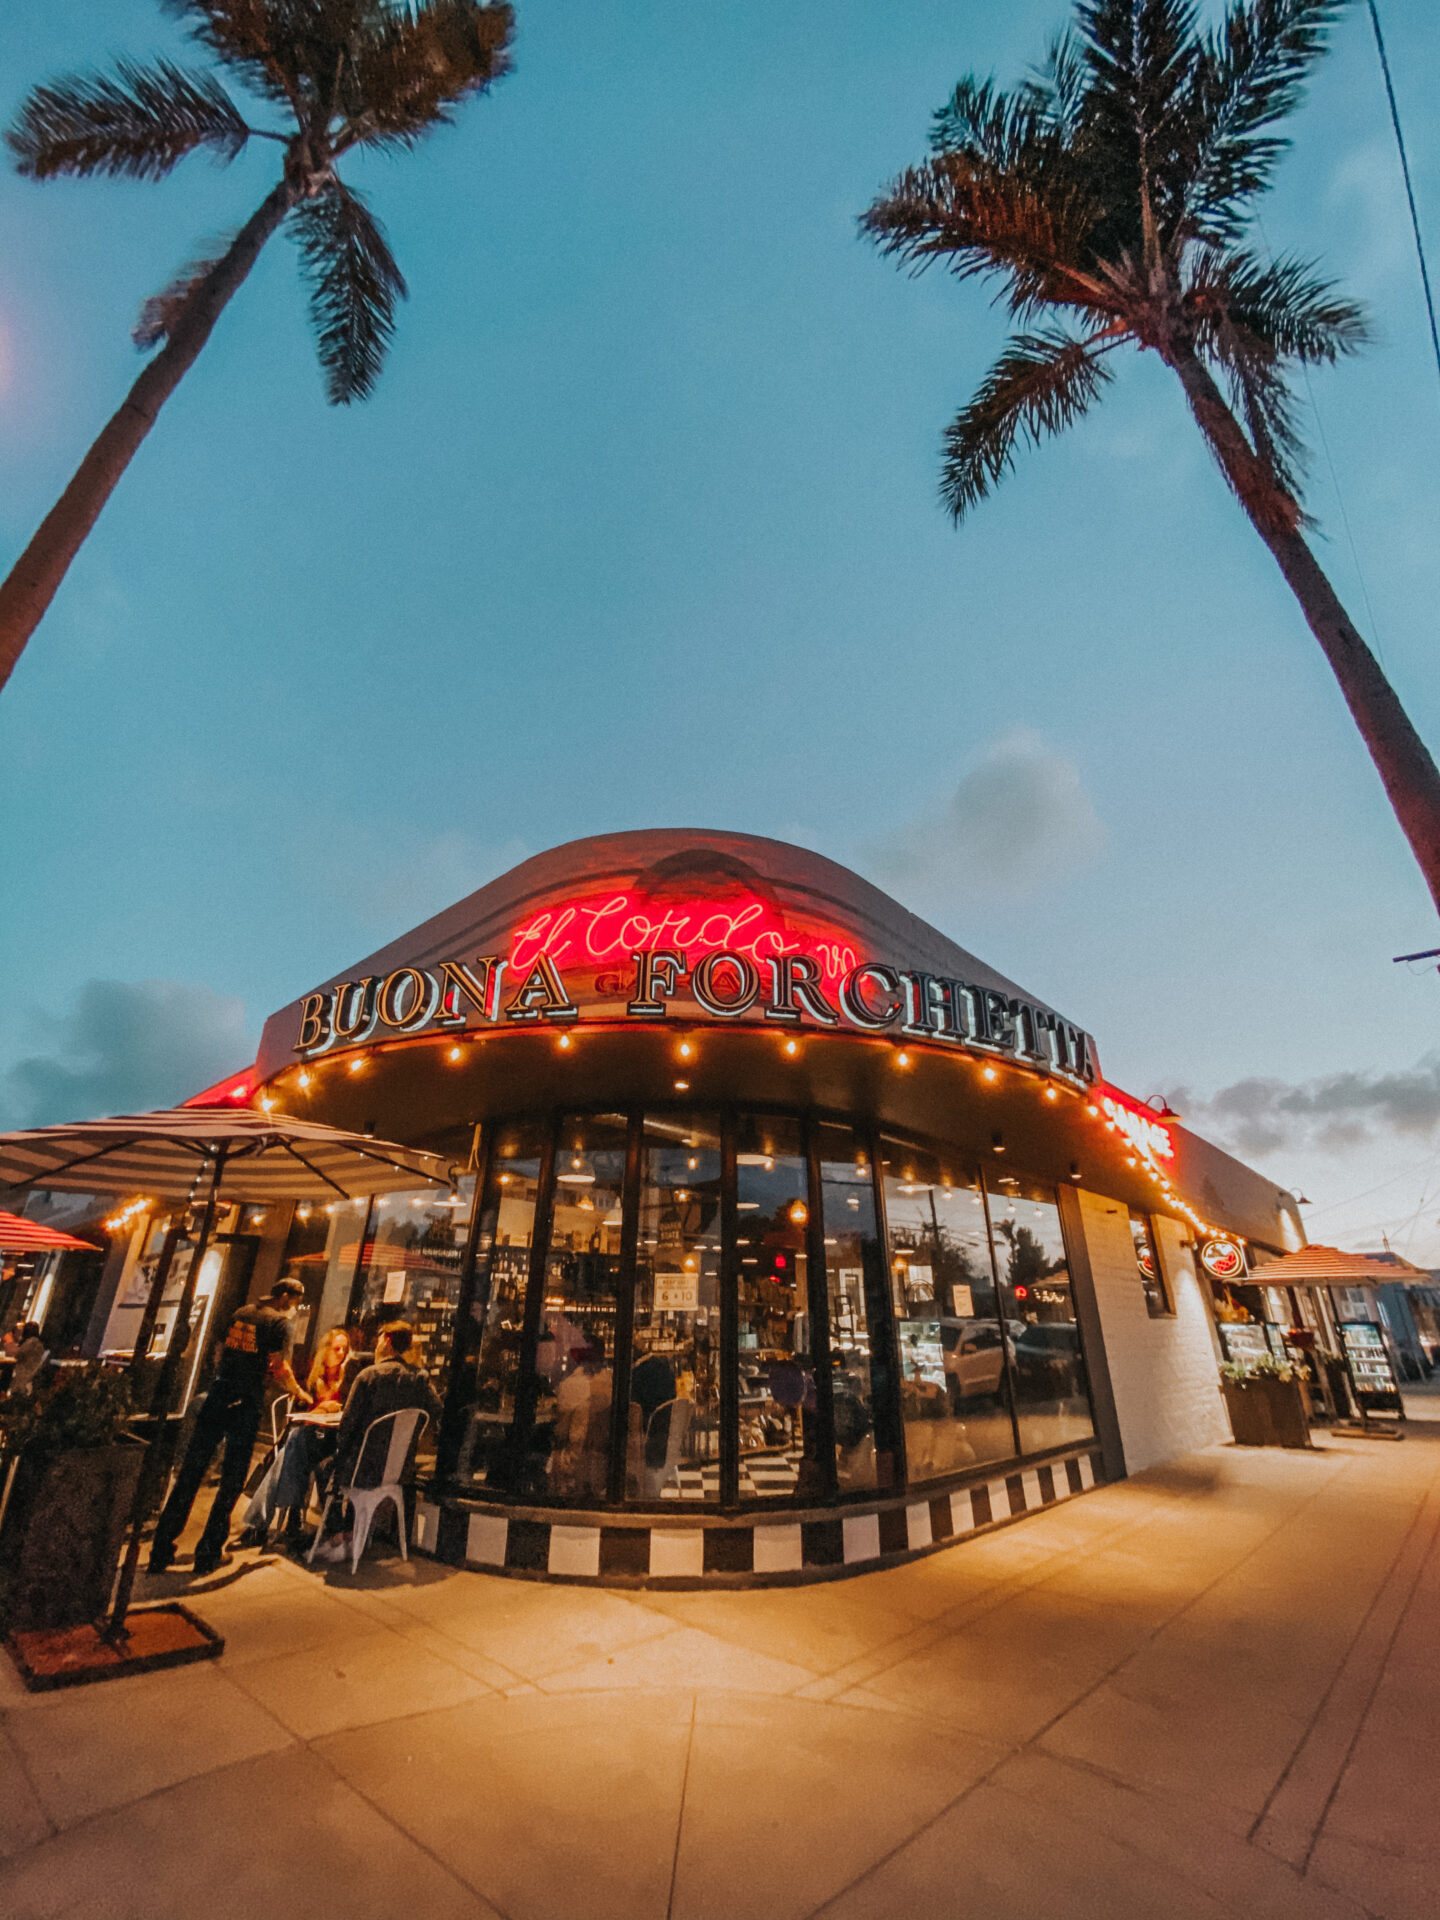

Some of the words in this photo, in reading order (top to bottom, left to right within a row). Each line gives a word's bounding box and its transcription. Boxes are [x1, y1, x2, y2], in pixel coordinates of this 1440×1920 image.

[510, 907, 573, 970] El
[293, 950, 579, 1056] BUONA
[626, 947, 1096, 1091] FORCHETTA
